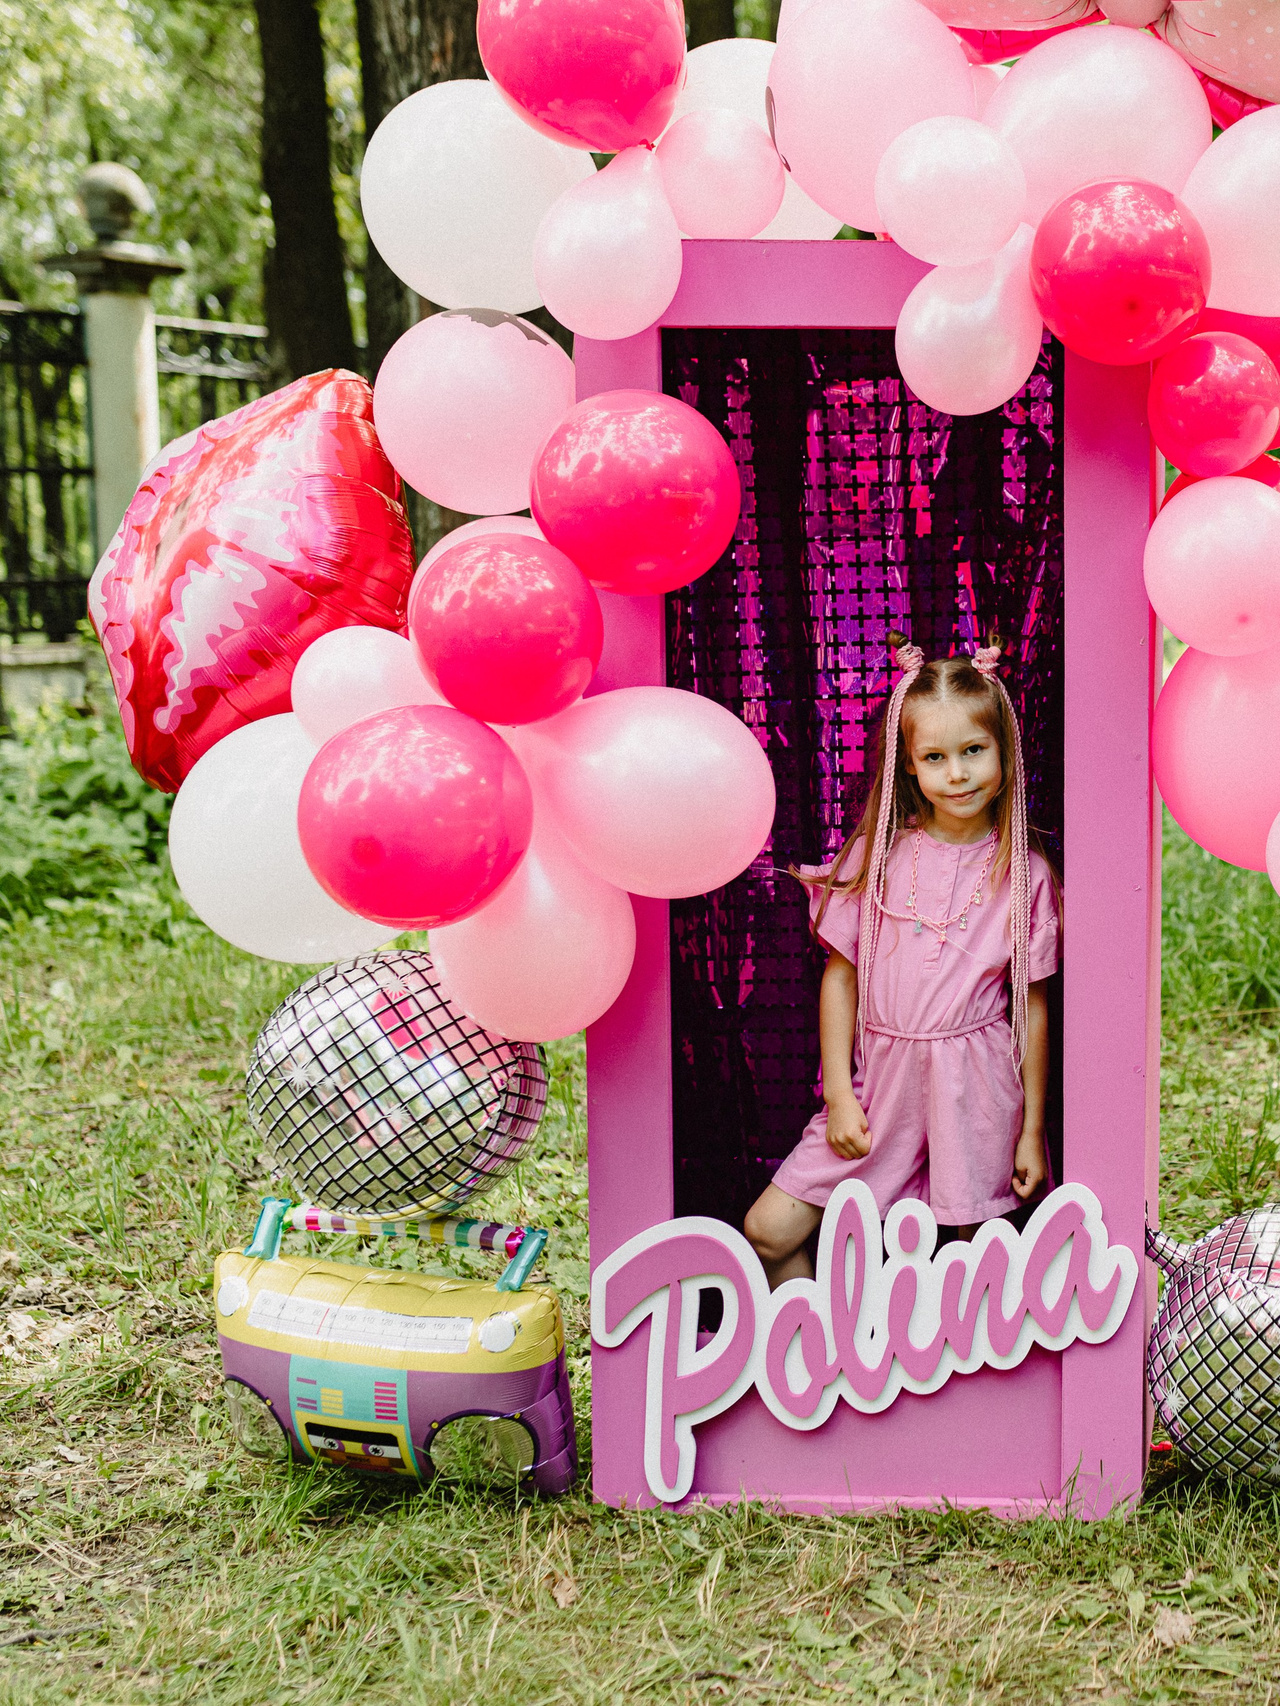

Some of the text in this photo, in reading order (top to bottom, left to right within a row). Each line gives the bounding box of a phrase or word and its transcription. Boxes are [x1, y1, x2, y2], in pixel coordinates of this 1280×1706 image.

[345, 1314, 357, 1322] 100
[363, 1315, 375, 1324] 110
[381, 1318, 394, 1326] 120
[400, 1321, 412, 1329] 130
[414, 1322, 427, 1330] 140
[433, 1323, 446, 1331] 150
[604, 1195, 1123, 1491] Polina
